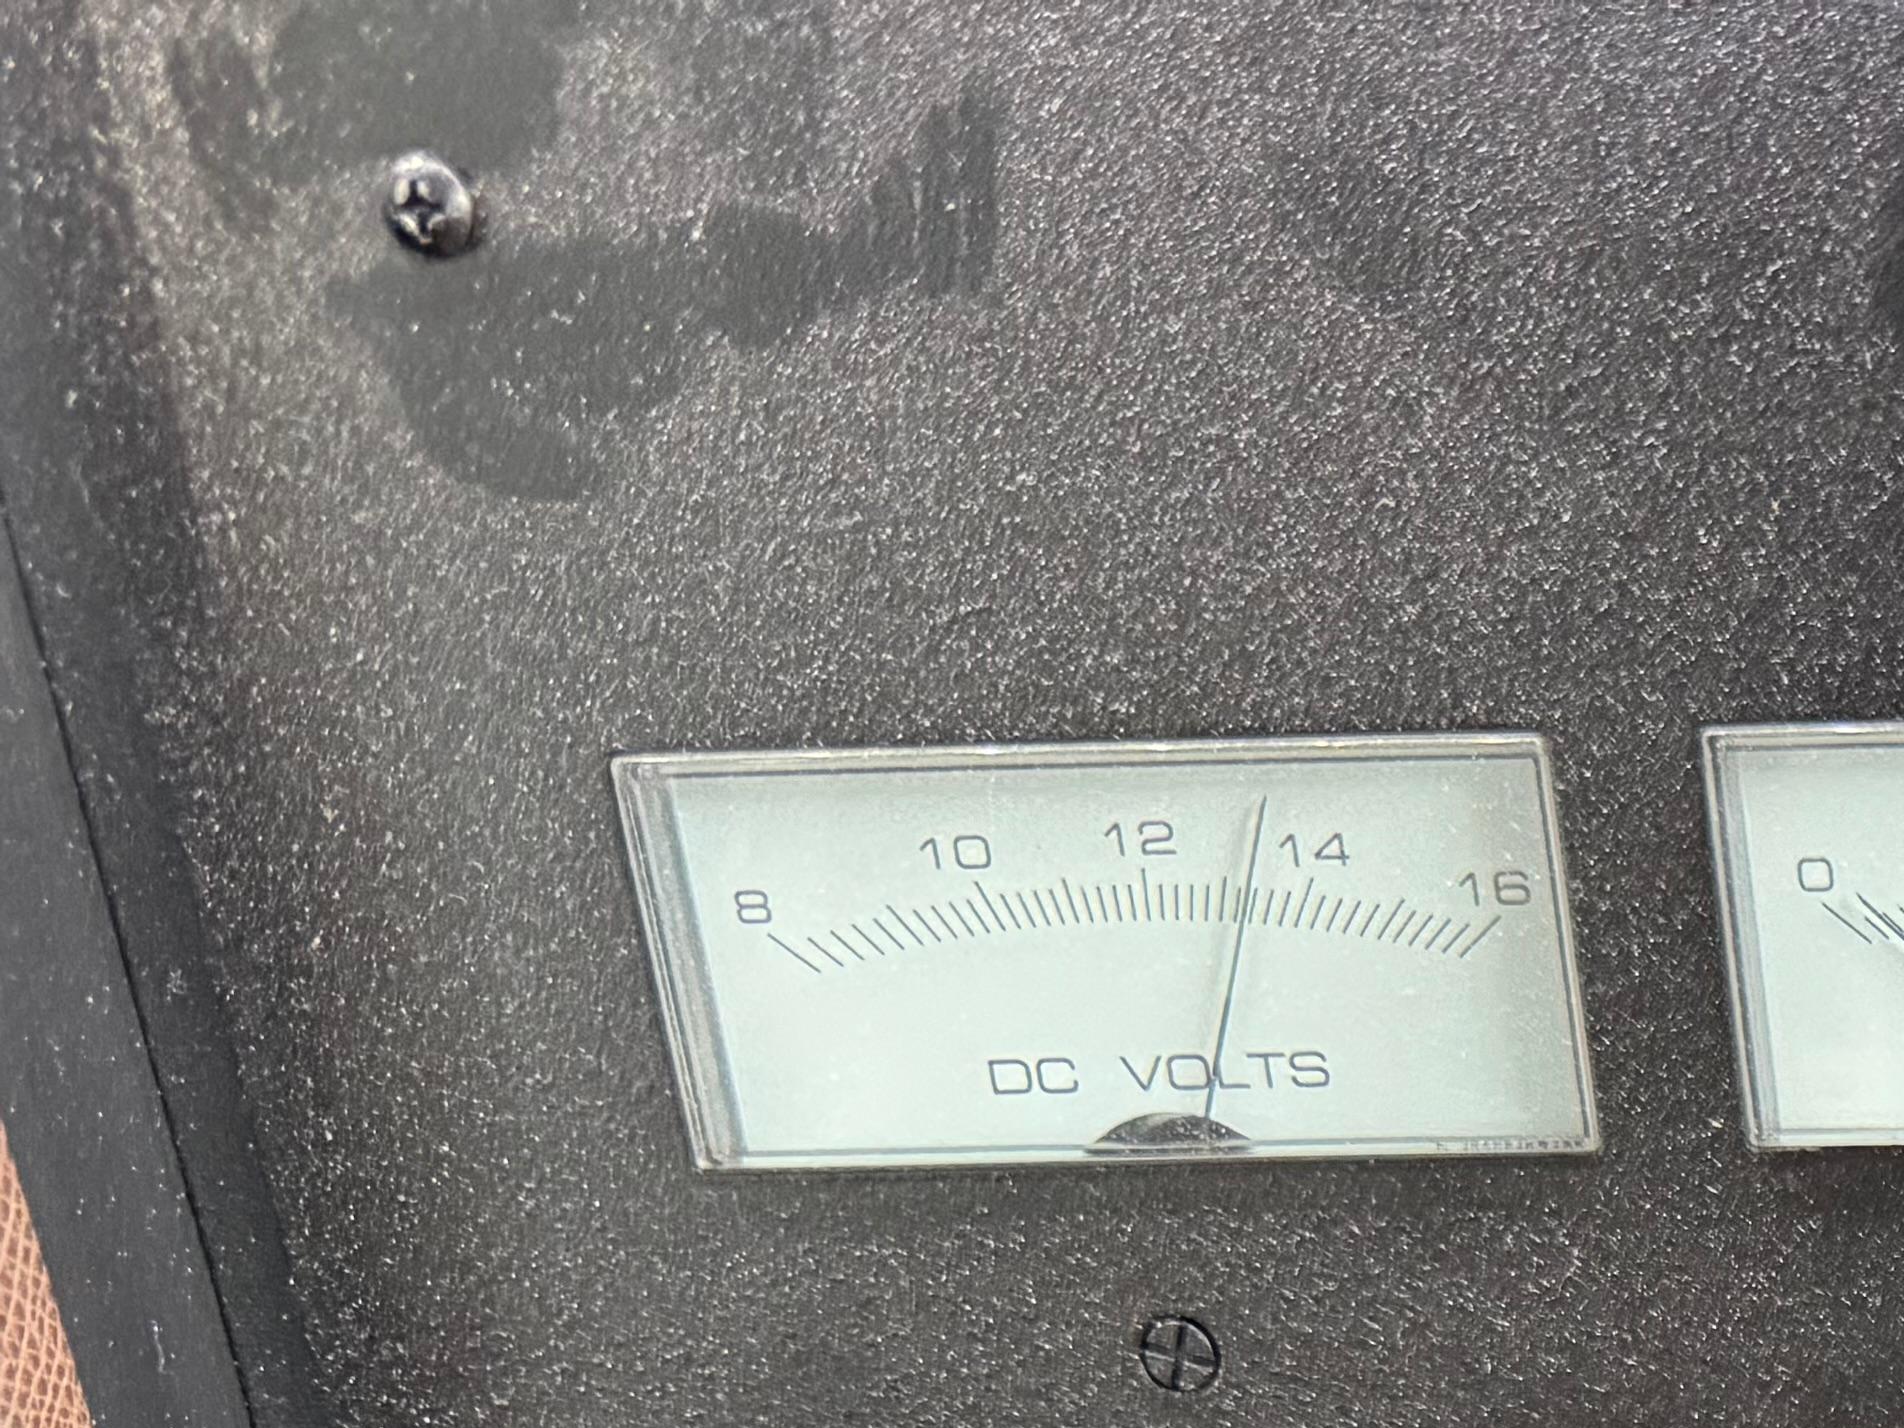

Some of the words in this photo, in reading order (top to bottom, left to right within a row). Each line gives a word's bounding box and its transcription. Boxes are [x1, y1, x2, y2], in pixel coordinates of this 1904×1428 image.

[919, 834, 992, 870] 10
[1103, 820, 1177, 857] 12
[1278, 832, 1351, 868] 14
[1459, 869, 1532, 907] 16
[1796, 856, 1835, 893] 0
[733, 889, 773, 925] 8
[987, 1057, 1079, 1096] DC
[1118, 1049, 1332, 1092] VOLTS
